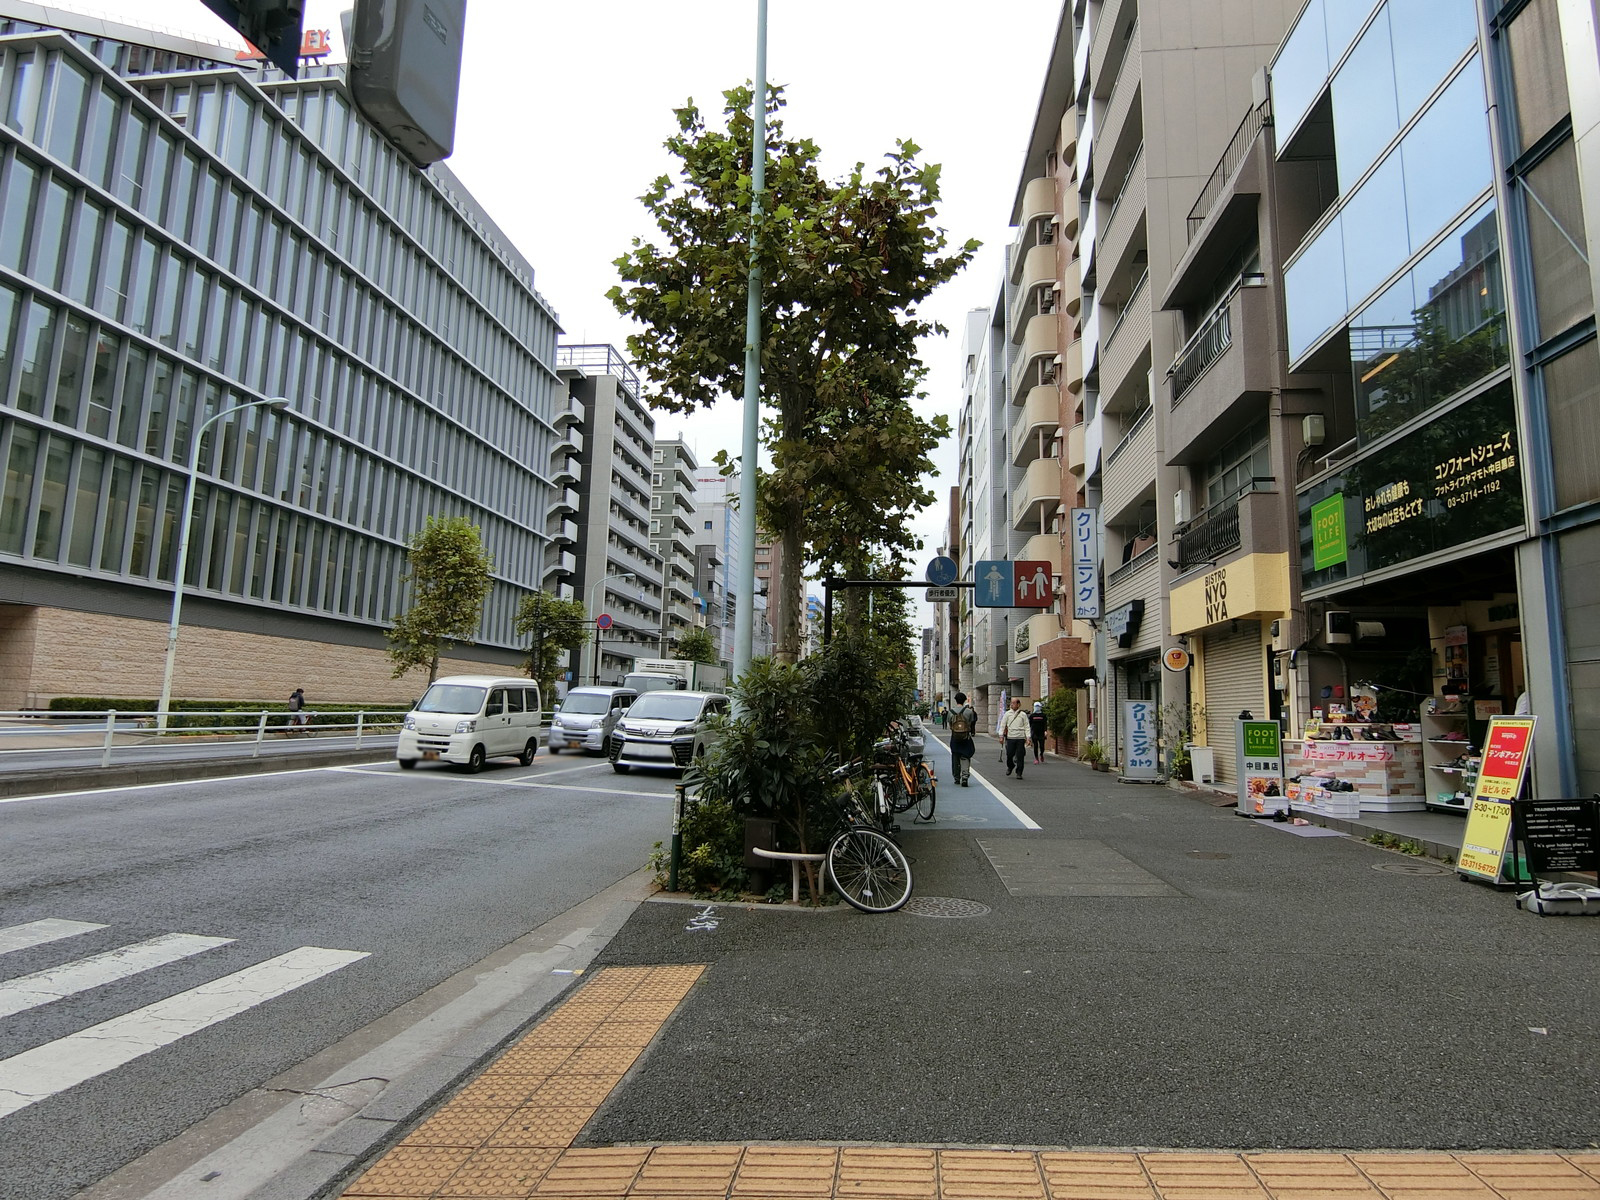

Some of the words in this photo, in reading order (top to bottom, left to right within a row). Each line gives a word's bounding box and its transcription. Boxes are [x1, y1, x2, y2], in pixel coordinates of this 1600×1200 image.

[1434, 431, 1511, 480] コンフォートシューズ
[1364, 480, 1410, 512] おしゃれも健康も
[1447, 480, 1501, 509] 03-3714-1192
[1317, 511, 1339, 531] FOOT
[1366, 497, 1423, 535] 大切なのは足もとです
[1318, 525, 1339, 544] LIFE
[1077, 512, 1095, 602] クリーニング
[1204, 568, 1227, 587] BISTRO
[929, 589, 955, 597] 歩行者優先
[1205, 580, 1227, 606] NYO
[1077, 606, 1097, 616] カトウ
[1206, 600, 1229, 625] NYA
[1131, 703, 1150, 756] クリーニング
[1247, 729, 1274, 737] FOOT
[1248, 737, 1274, 745] LIFE
[1129, 759, 1153, 767] カトウ
[1303, 749, 1394, 761] リニューアルオープン
[1488, 749, 1522, 760] テンポアップ
[1246, 761, 1279, 771] 中目黒店
[1460, 858, 1497, 874] 03-3715-6722
